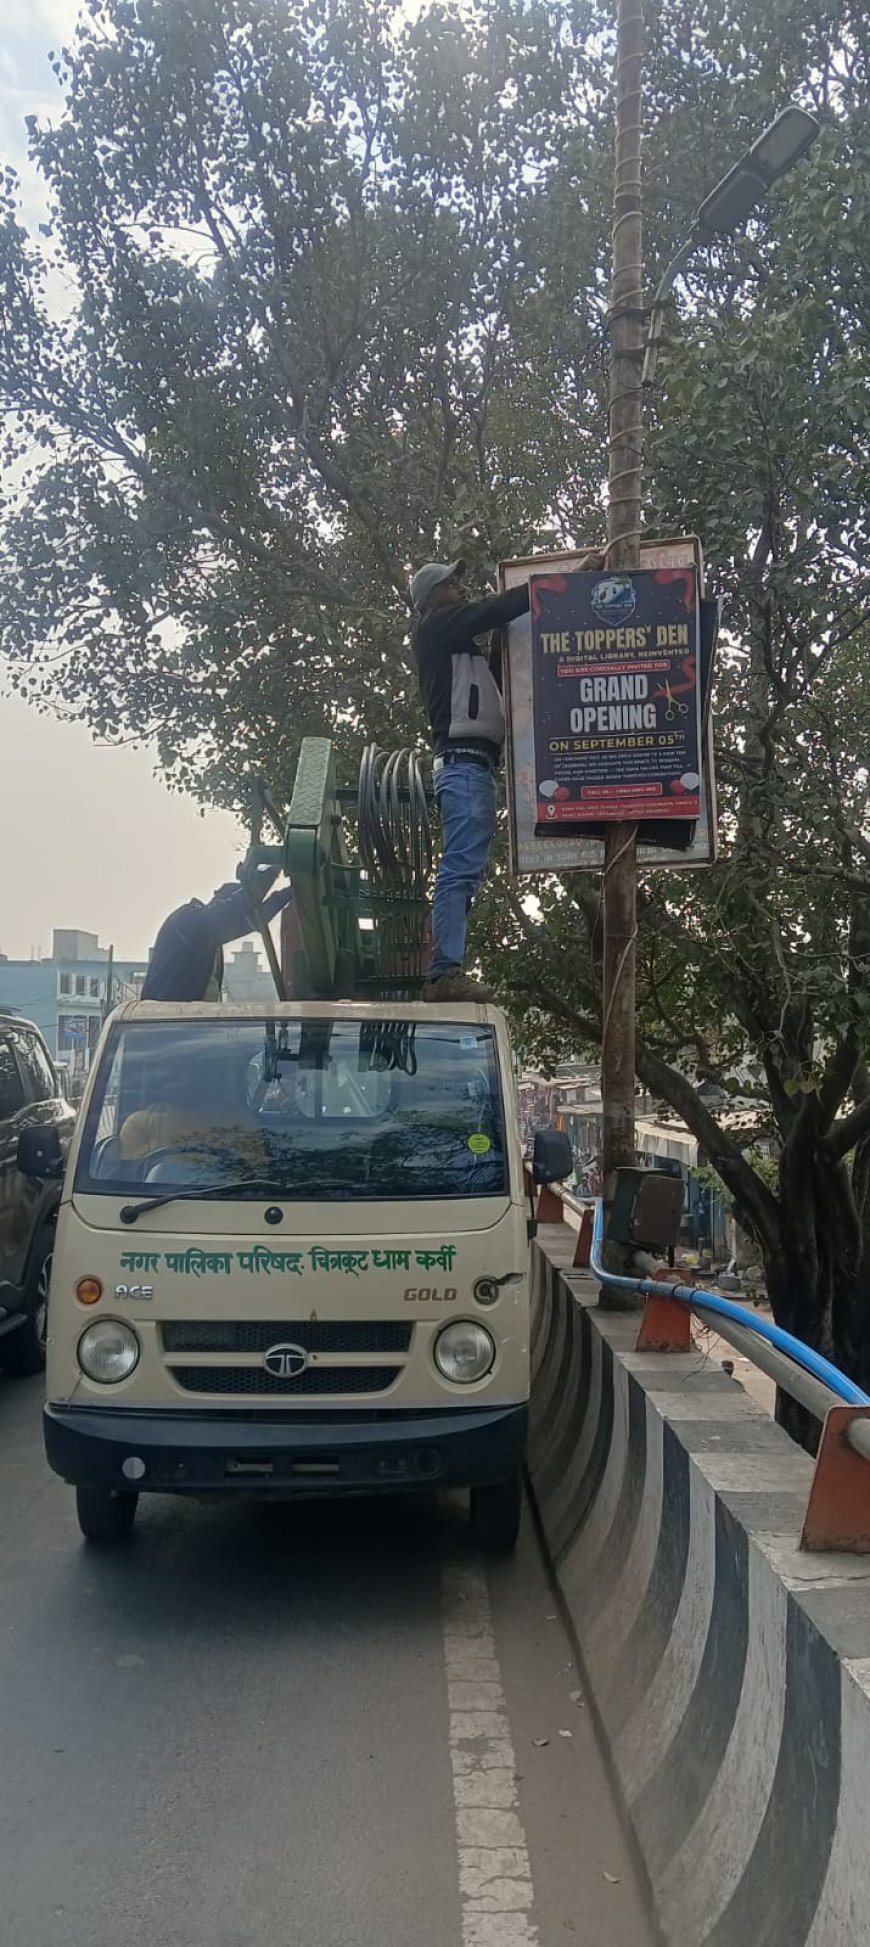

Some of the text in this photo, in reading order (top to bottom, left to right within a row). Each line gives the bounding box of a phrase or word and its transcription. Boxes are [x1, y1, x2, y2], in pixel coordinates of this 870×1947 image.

[540, 623, 689, 654] THE TOPPERS' DEN
[638, 648, 690, 658] REINVENTED
[560, 661, 668, 675] YOU ARE CORDIALLY INVITED FOR
[580, 674, 648, 703] GRAND
[570, 703, 657, 733] OPENING
[550, 741, 569, 751] ON
[573, 737, 654, 750] SEPTEMBER
[120, 1251, 161, 1274] नगर
[164, 1247, 233, 1277] पालिका
[370, 1249, 411, 1271] धाम
[414, 1245, 457, 1272] कर्वी
[114, 1284, 154, 1300] ACE
[403, 1287, 458, 1301] GOLD
